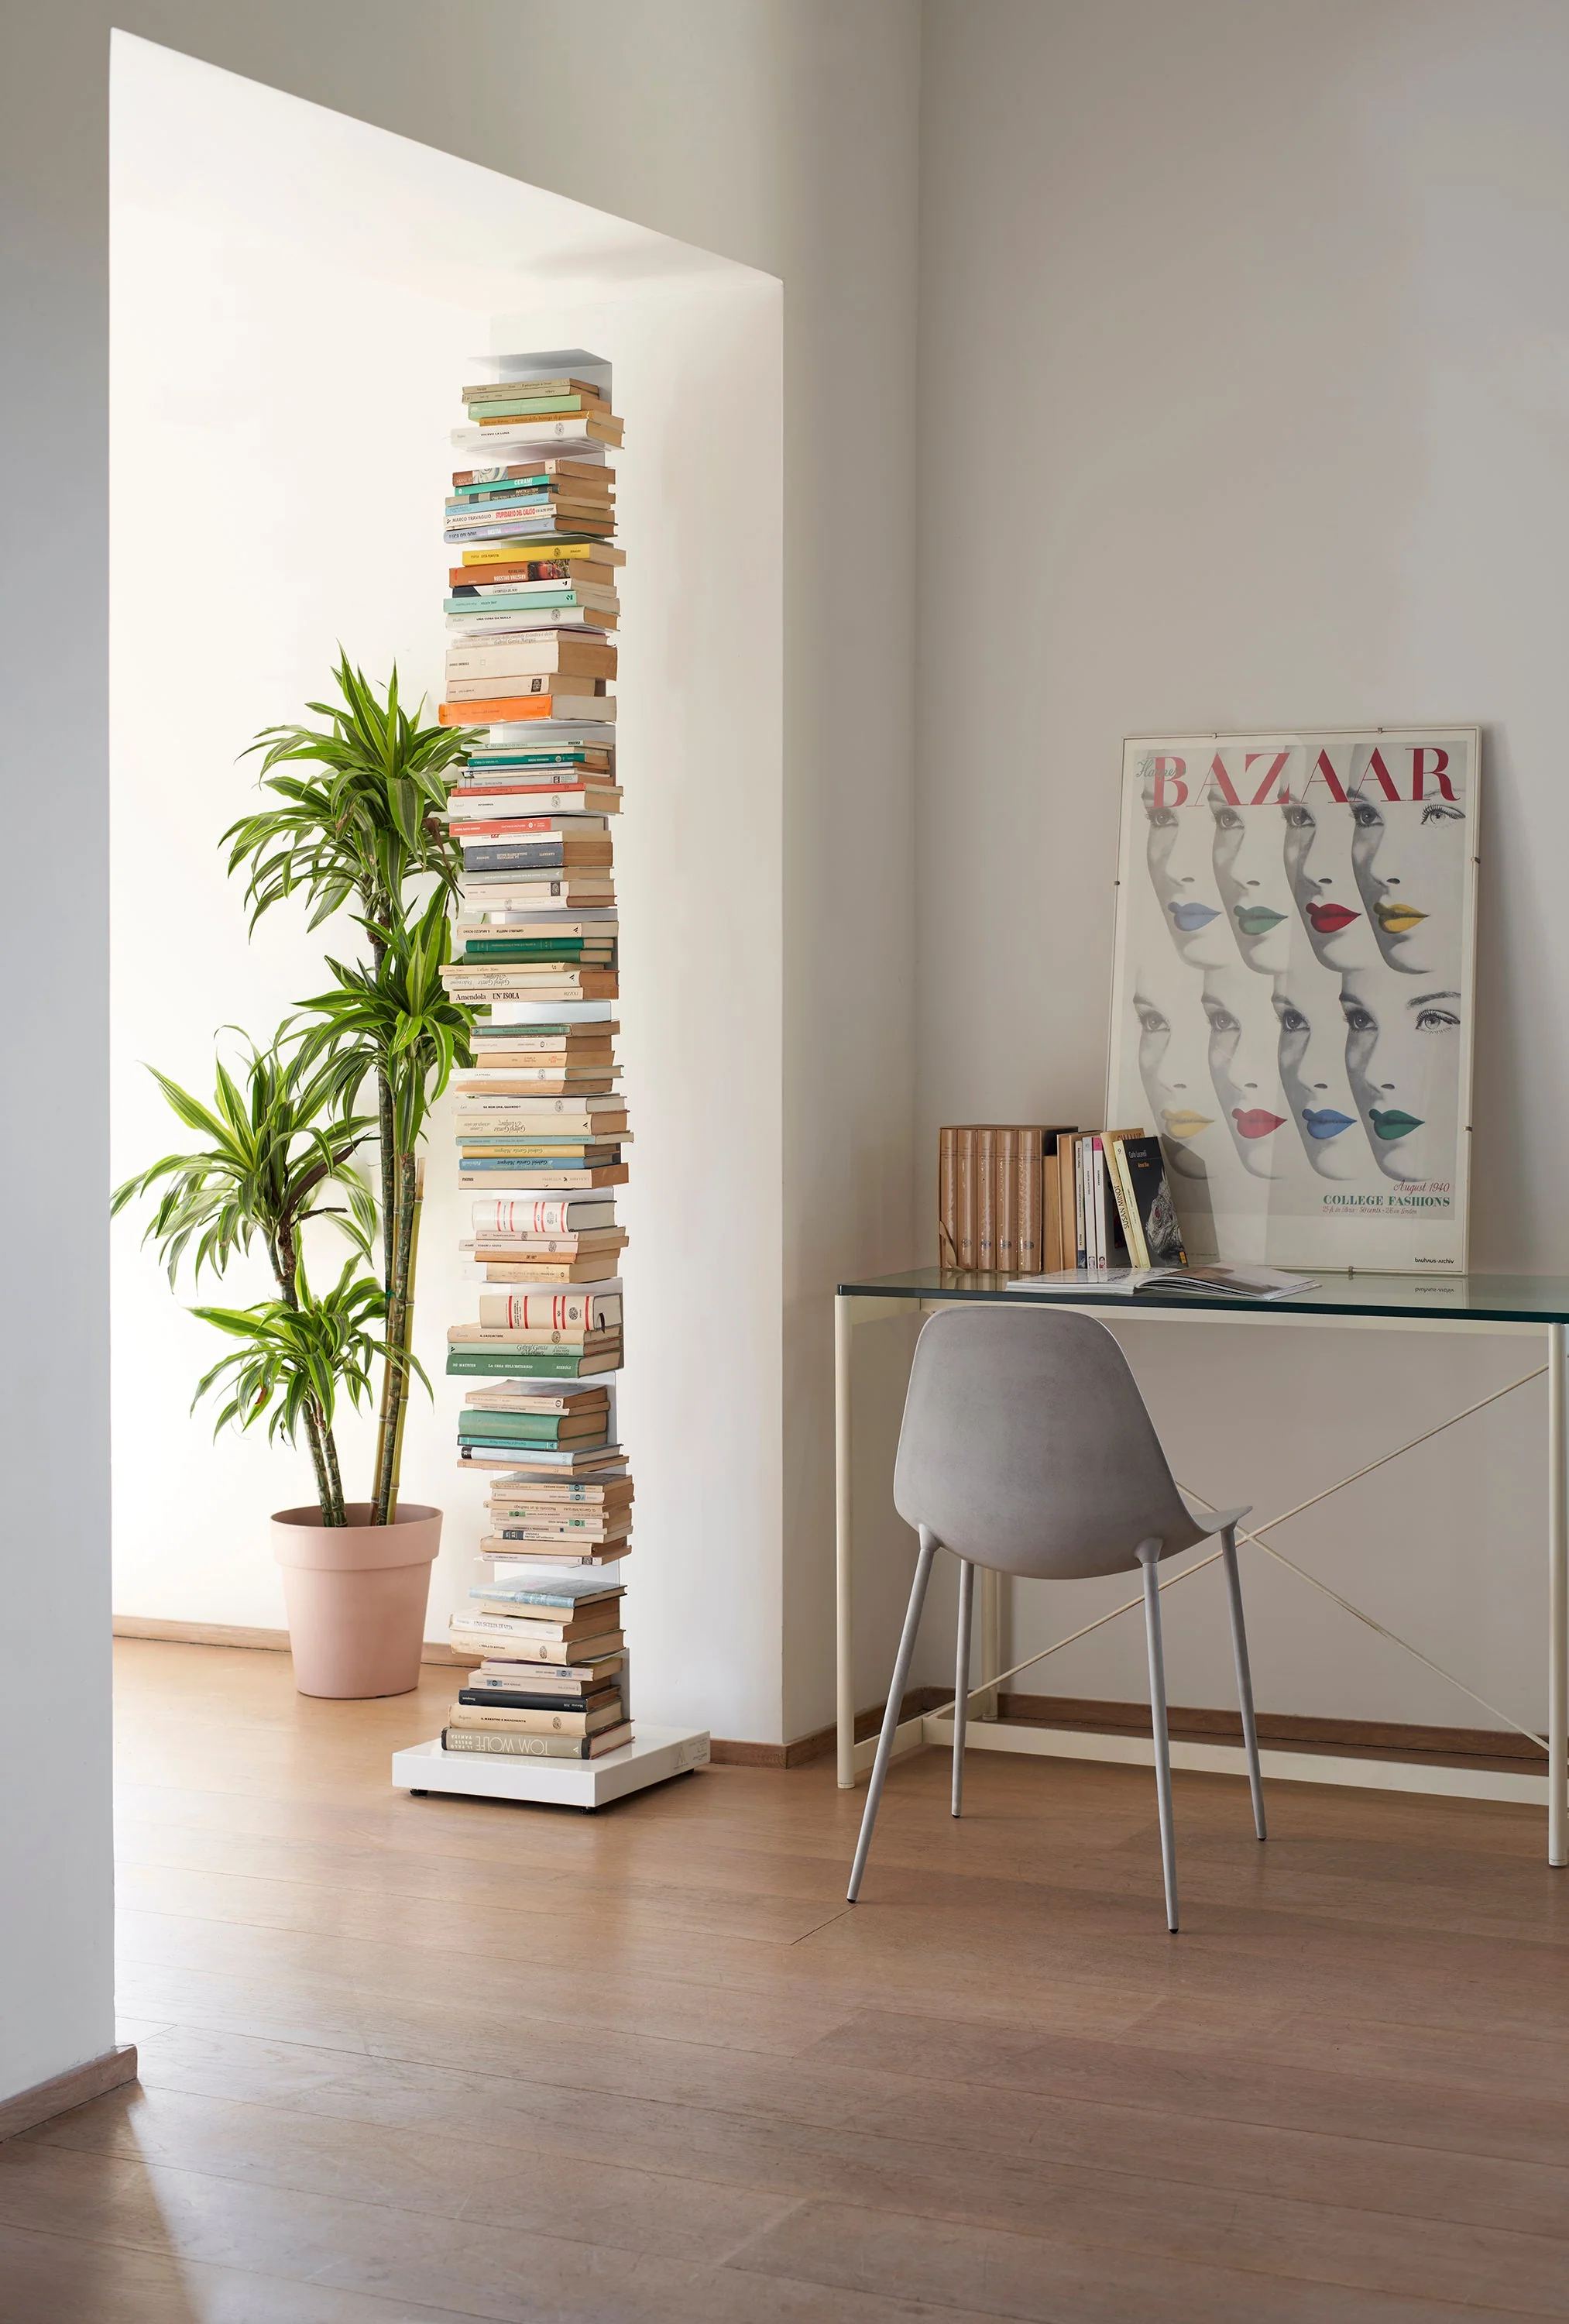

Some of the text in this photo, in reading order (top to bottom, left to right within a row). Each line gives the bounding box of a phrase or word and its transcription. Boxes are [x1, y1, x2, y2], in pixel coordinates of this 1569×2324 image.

[1145, 747, 1461, 809] BAZAAR
[1394, 1179, 1450, 1195] August 1940
[1114, 1185, 1130, 1229] SUSAN MINOT
[1324, 1195, 1450, 1207] COLLEGE FASHIONS
[475, 1736, 551, 1755] TOM WOLFE
